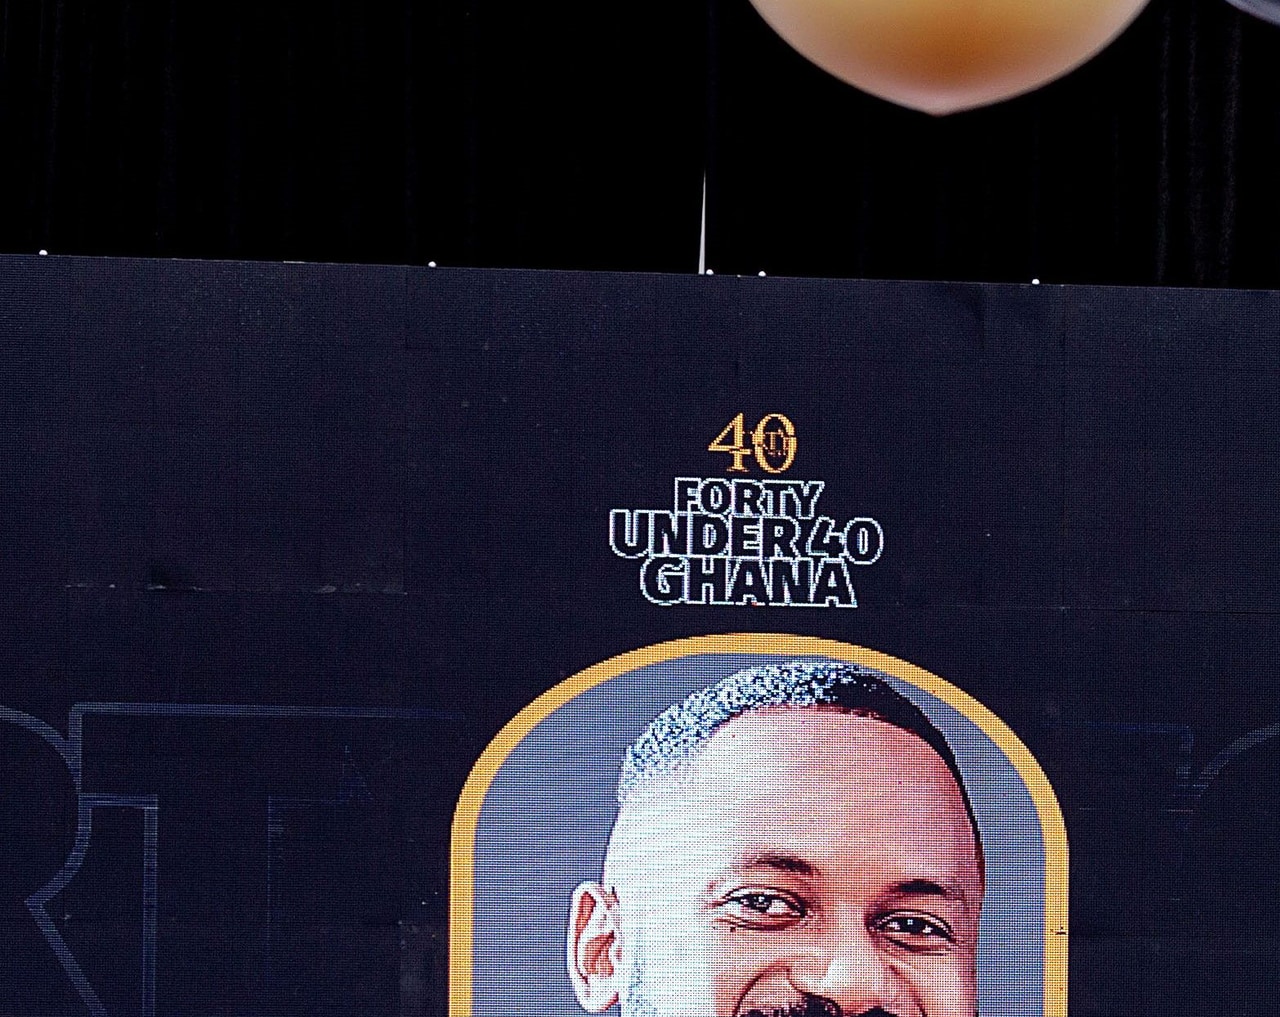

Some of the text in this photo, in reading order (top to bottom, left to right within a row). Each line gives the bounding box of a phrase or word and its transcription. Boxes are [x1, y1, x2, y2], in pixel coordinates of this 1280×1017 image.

[708, 412, 797, 472] 40
[675, 477, 825, 519] FORTY
[609, 509, 884, 565] UNDER 40
[640, 554, 858, 608] GHANA
